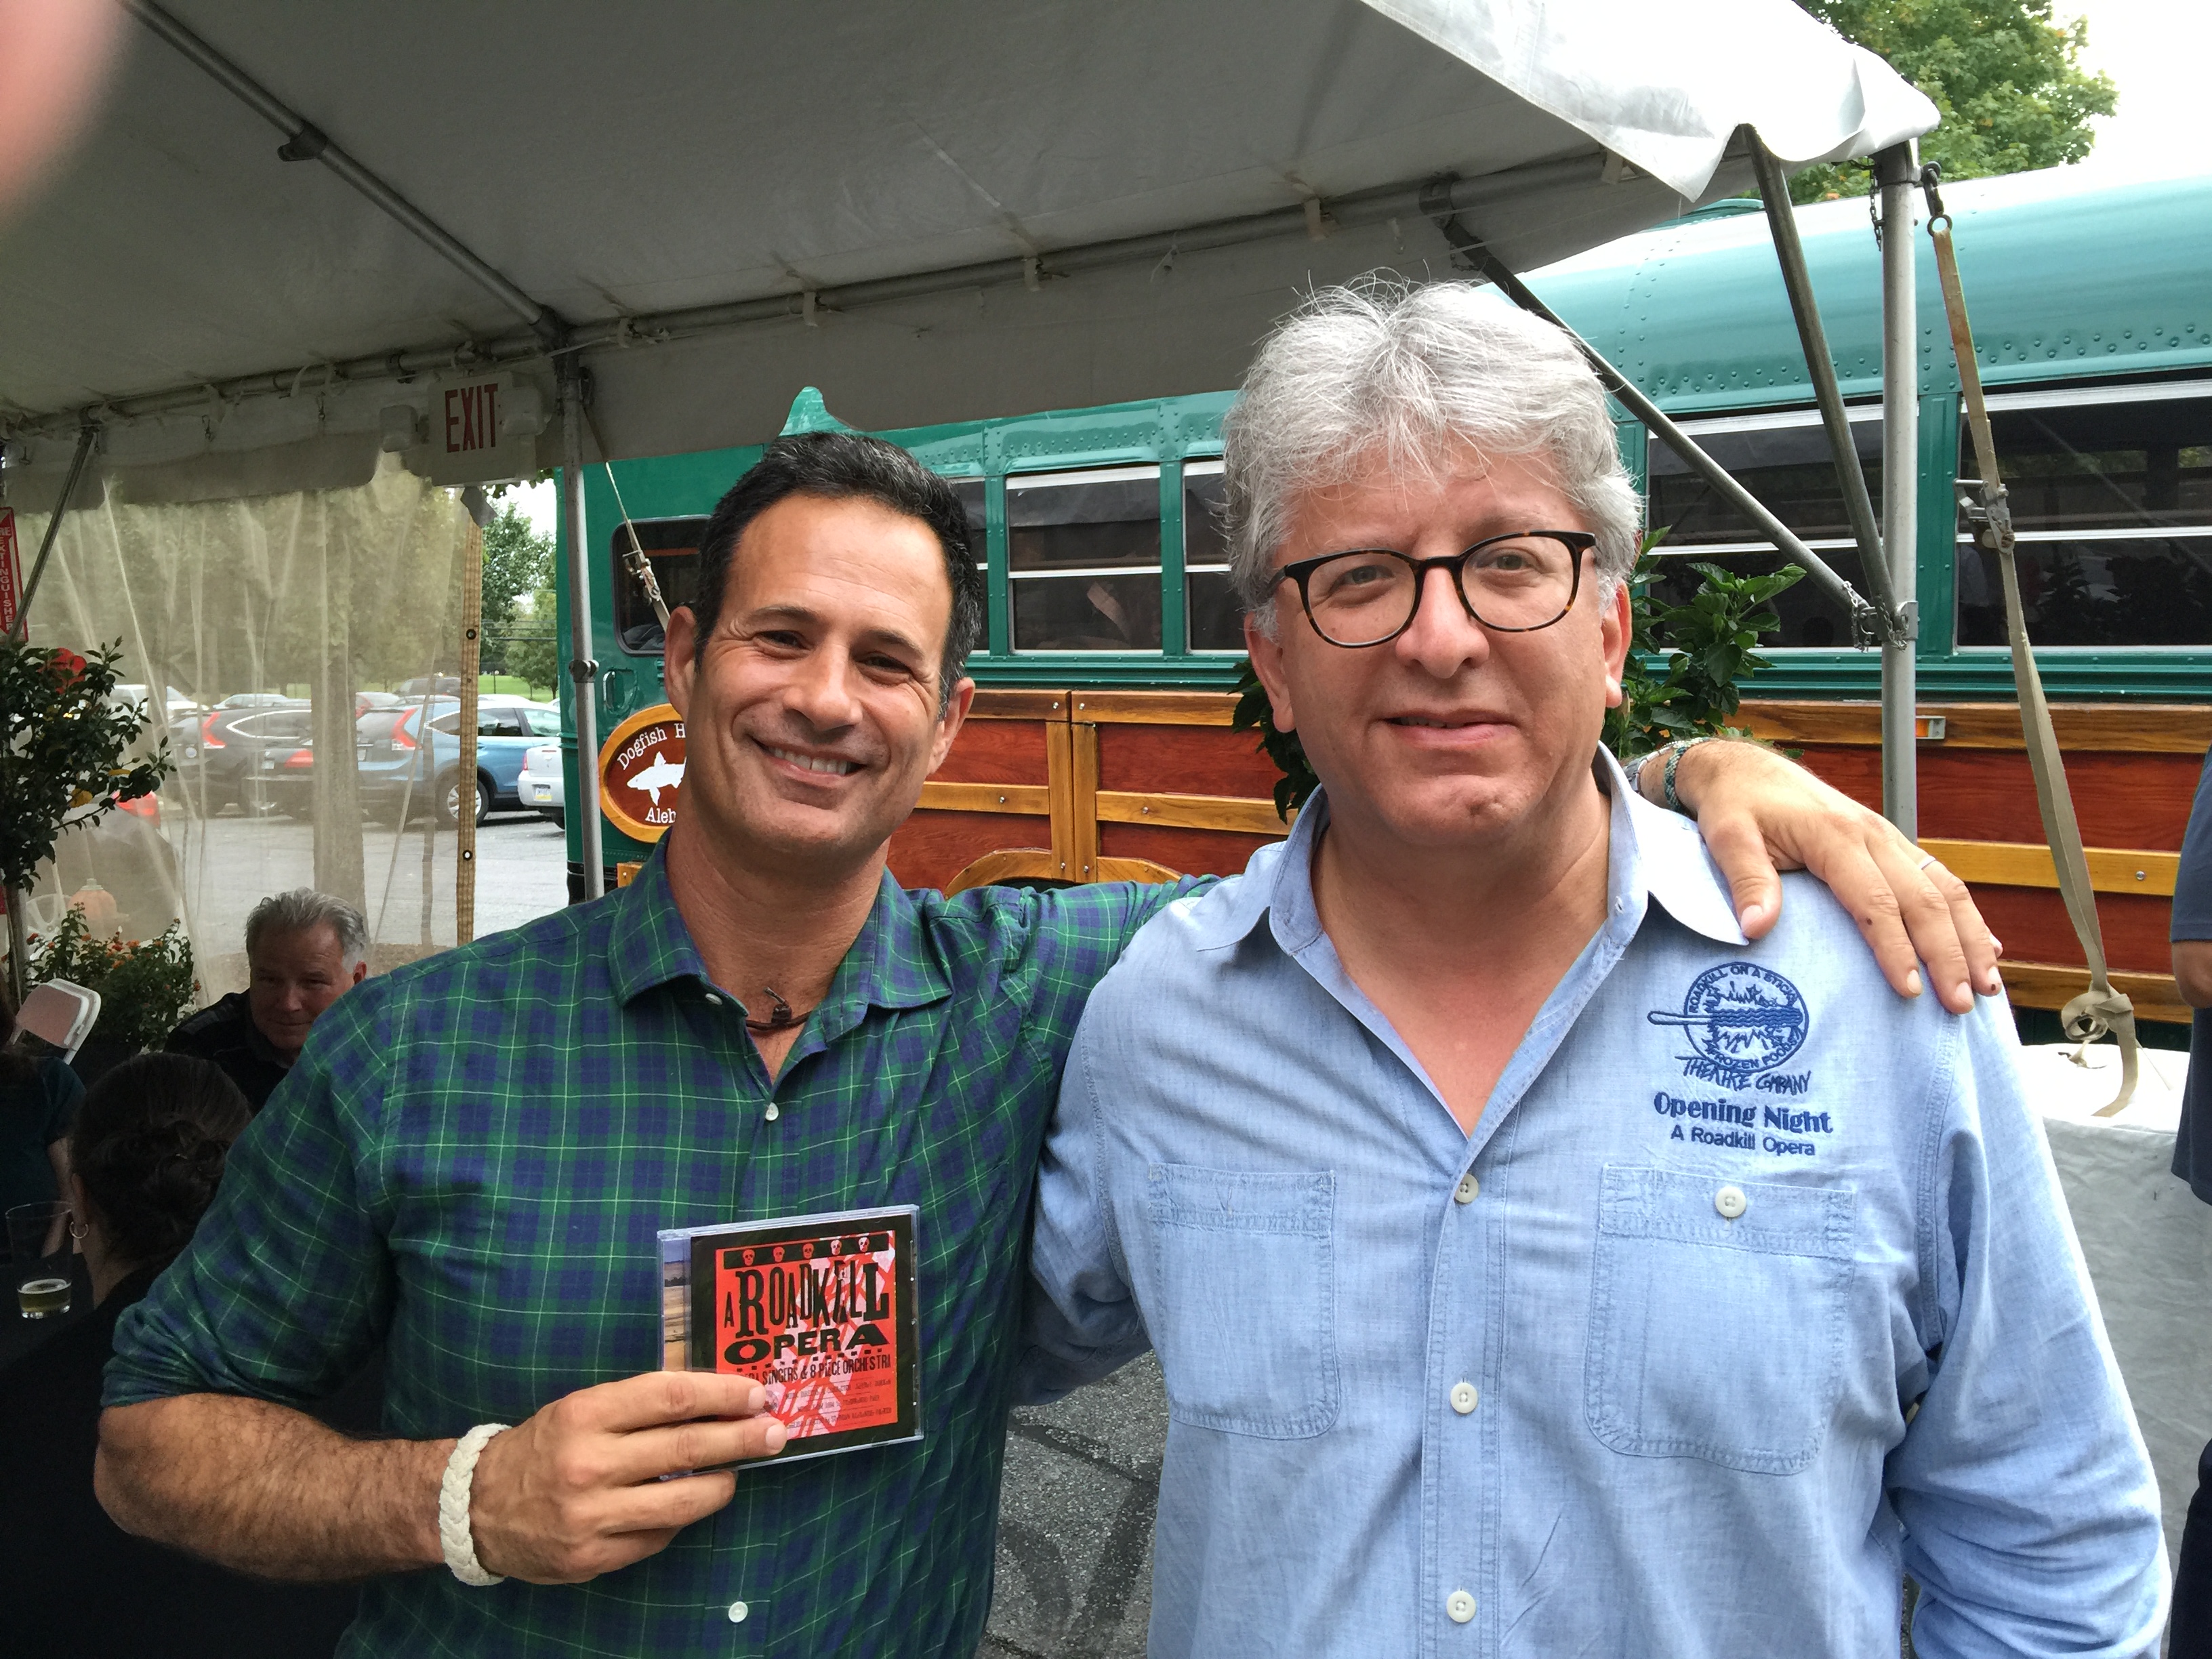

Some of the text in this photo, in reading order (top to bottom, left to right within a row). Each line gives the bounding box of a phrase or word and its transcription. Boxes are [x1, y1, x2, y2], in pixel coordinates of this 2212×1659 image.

[445, 383, 498, 453] EXIT
[617, 726, 668, 771] Dogfish
[1688, 969, 1728, 1013] ROADKILL
[1730, 965, 1748, 975] ON
[1752, 967, 1761, 978] A
[1675, 1055, 1751, 1092] THEATRE
[1709, 1040, 1797, 1069] FROZEN FOODS
[1654, 1091, 1833, 1134] Opening Night
[1671, 1124, 1815, 1156] A Roadkill Opera
[724, 1260, 890, 1338] A ROADKILL
[724, 1324, 890, 1364] OPERA
[762, 1366, 798, 1385] SINGERS
[800, 1365, 808, 1382] &
[810, 1364, 817, 1378] 8
[818, 1359, 841, 1378] PIECE
[843, 1353, 891, 1376] ORCHESTRA
